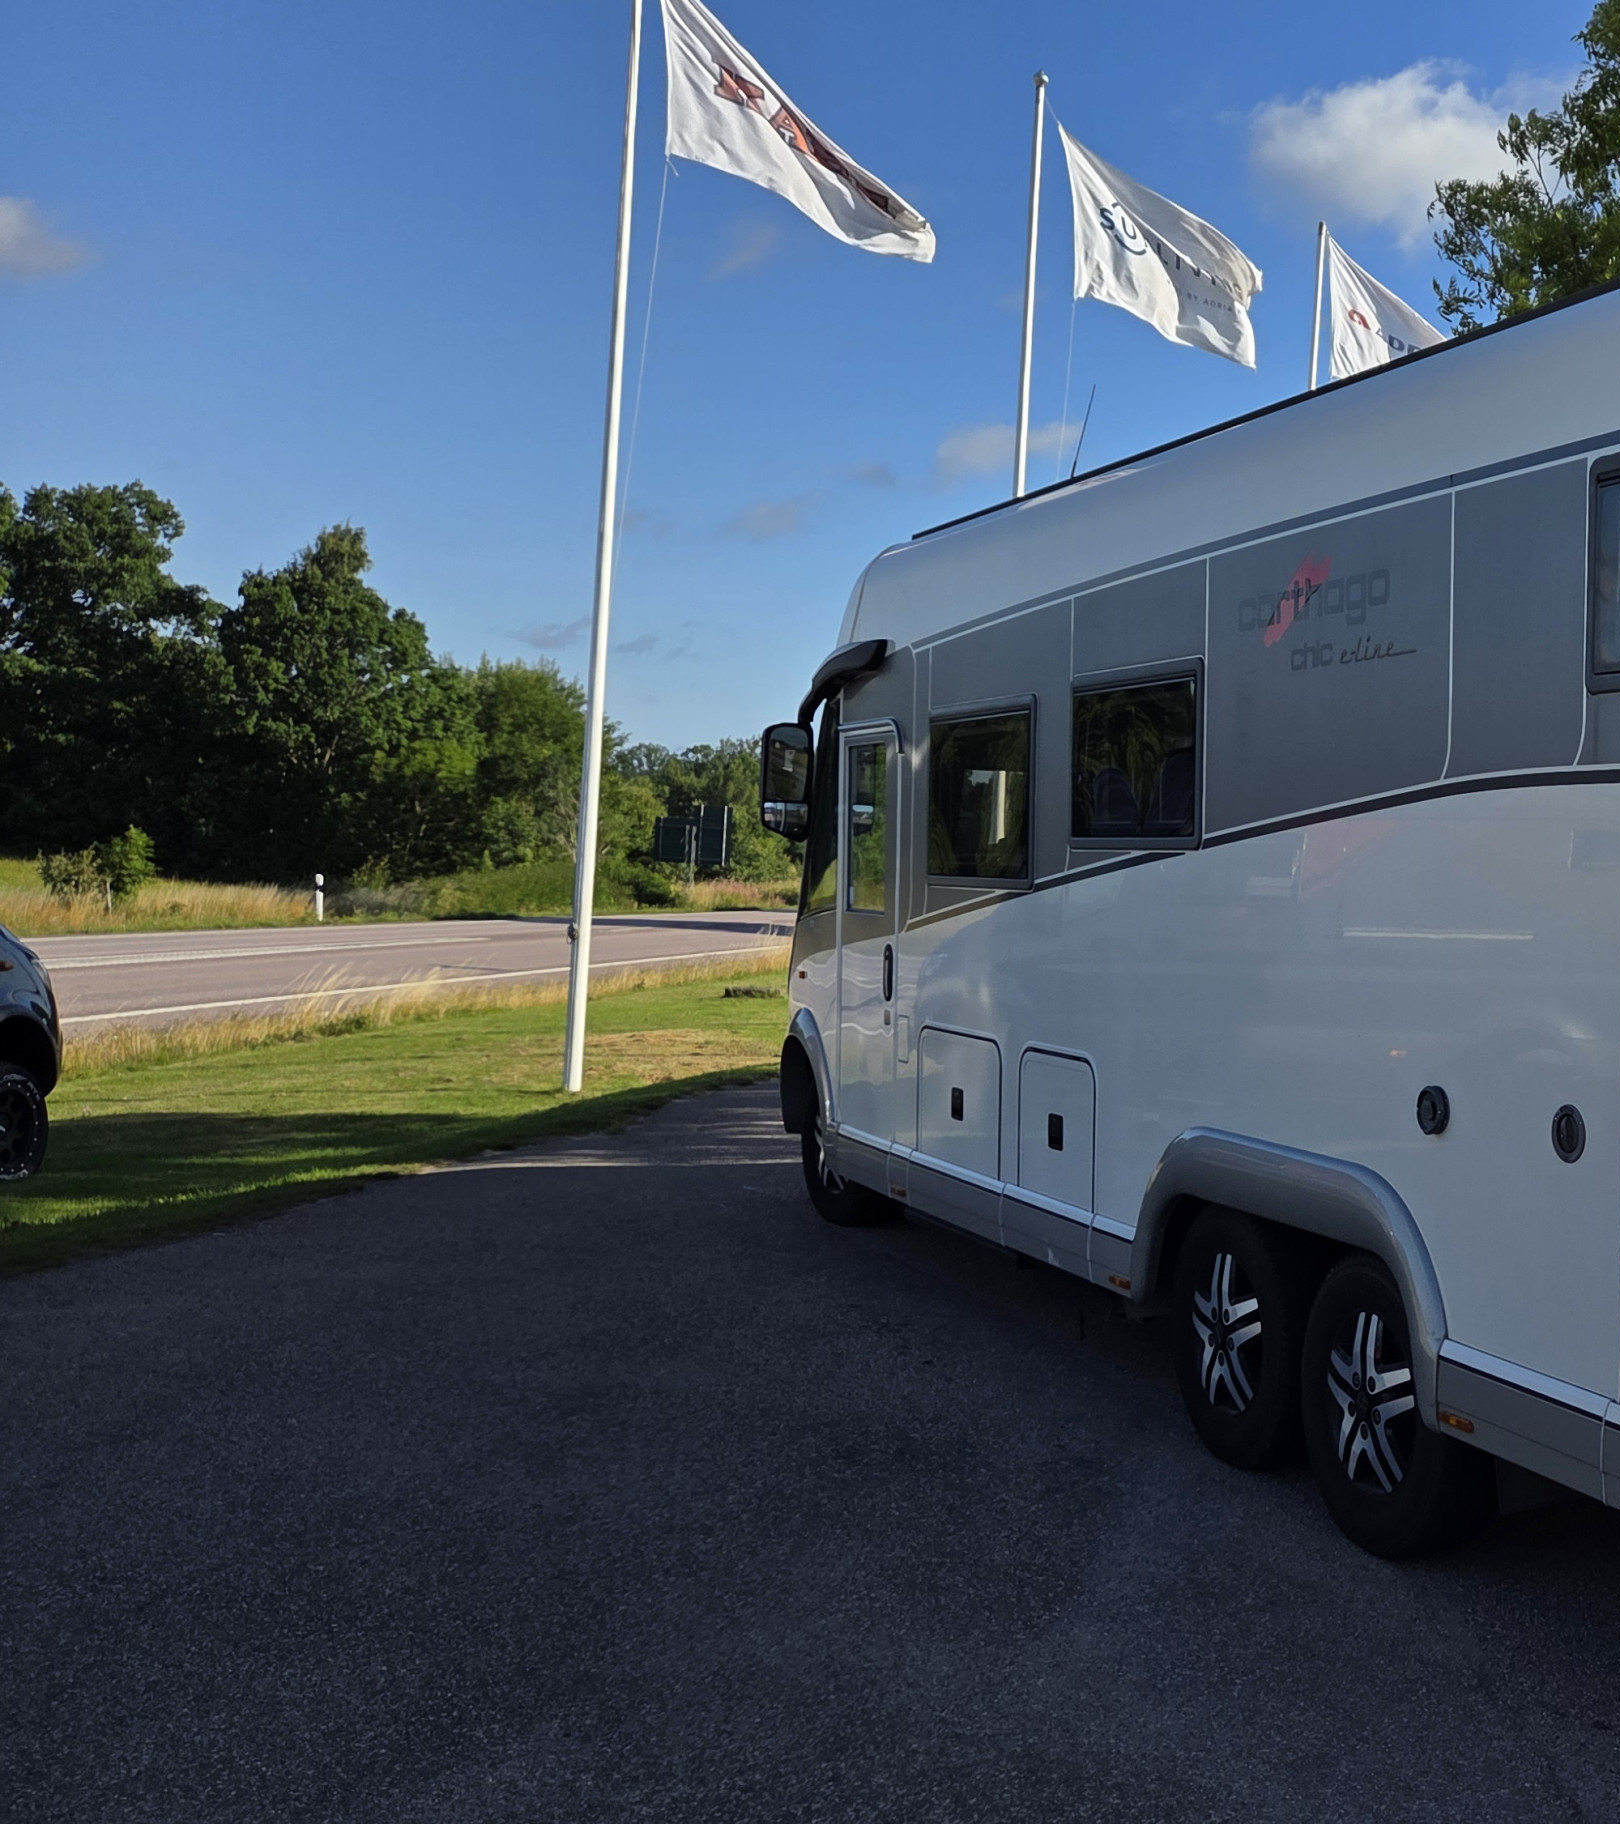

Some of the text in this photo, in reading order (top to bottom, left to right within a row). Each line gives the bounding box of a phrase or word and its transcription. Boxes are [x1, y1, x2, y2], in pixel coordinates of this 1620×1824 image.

[1237, 567, 1391, 633] carthago
[1290, 635, 1417, 672] chic e-line
